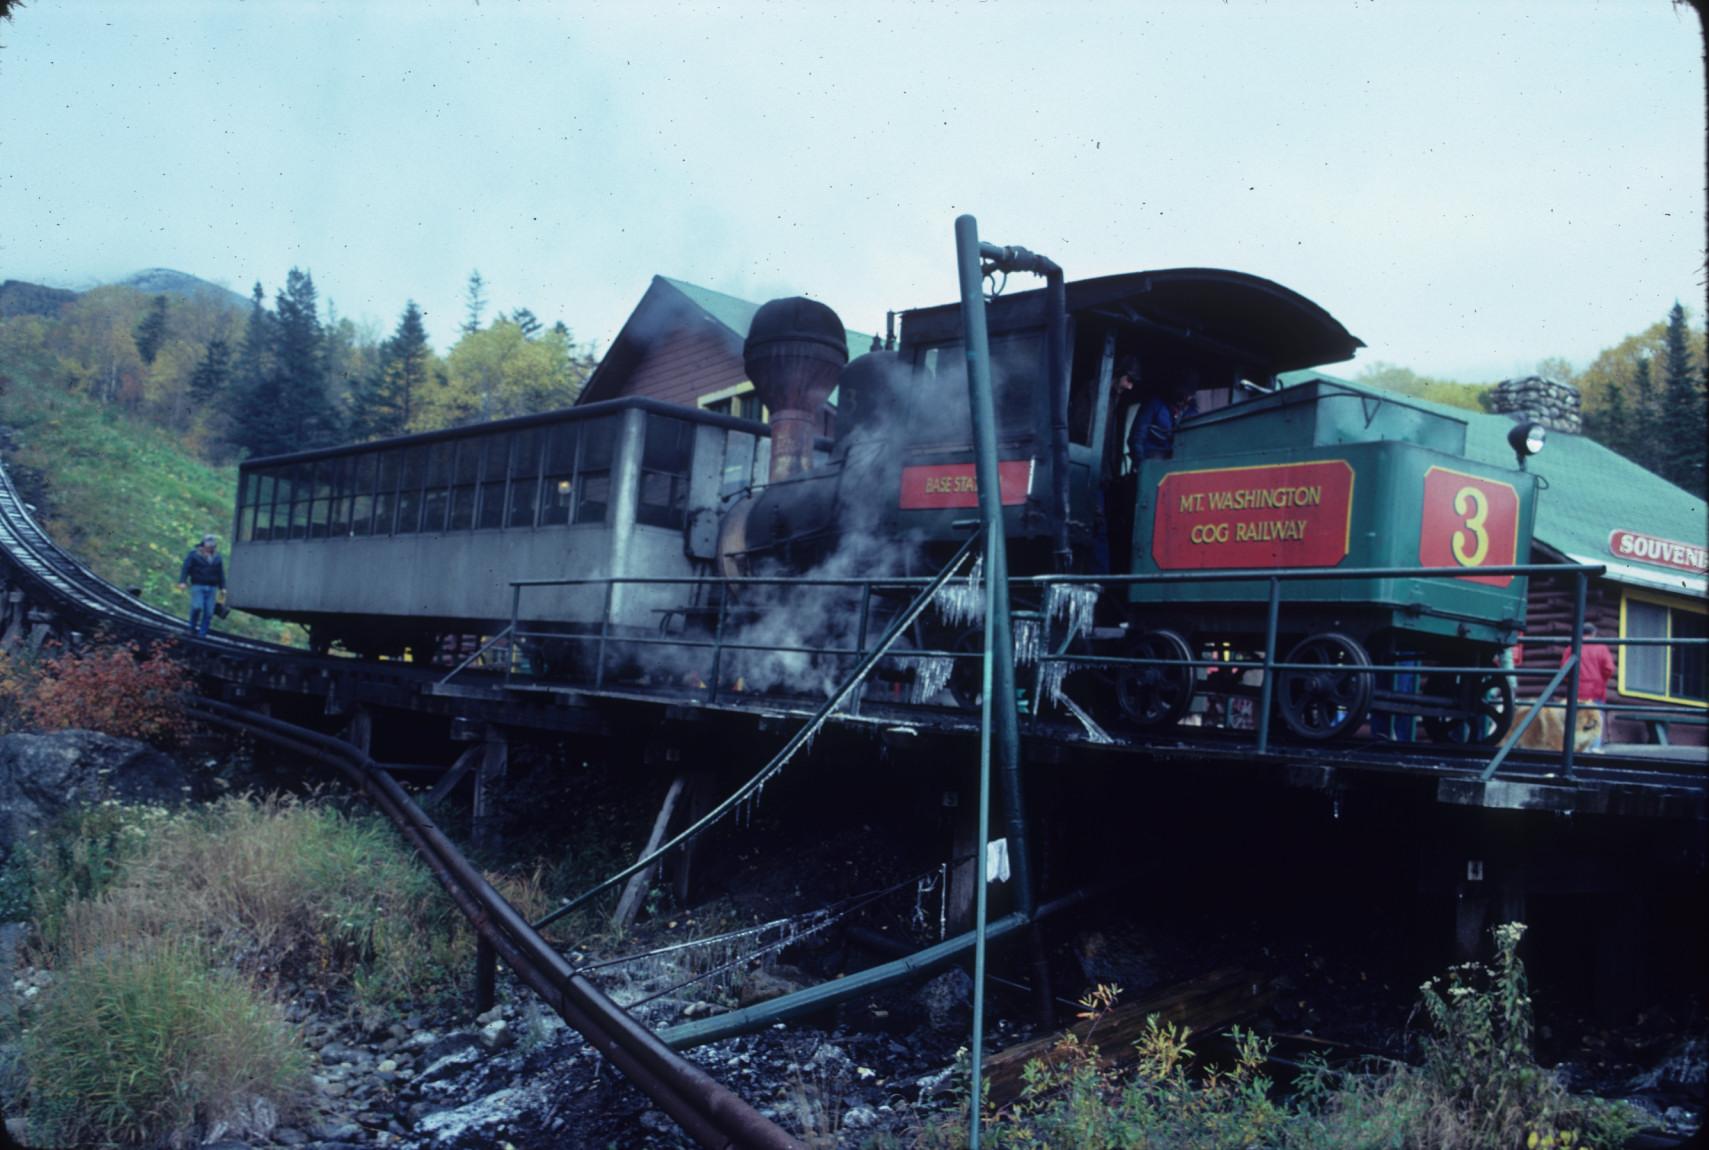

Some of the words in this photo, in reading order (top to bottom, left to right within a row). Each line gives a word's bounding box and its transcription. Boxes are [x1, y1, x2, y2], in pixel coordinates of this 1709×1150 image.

[925, 476, 952, 493] BASE
[1180, 493, 1204, 512] MT.
[1208, 486, 1322, 510] WASHINGTON
[1190, 523, 1229, 545] COG
[1235, 520, 1308, 542] RAILWAY
[1451, 486, 1489, 567] 3
